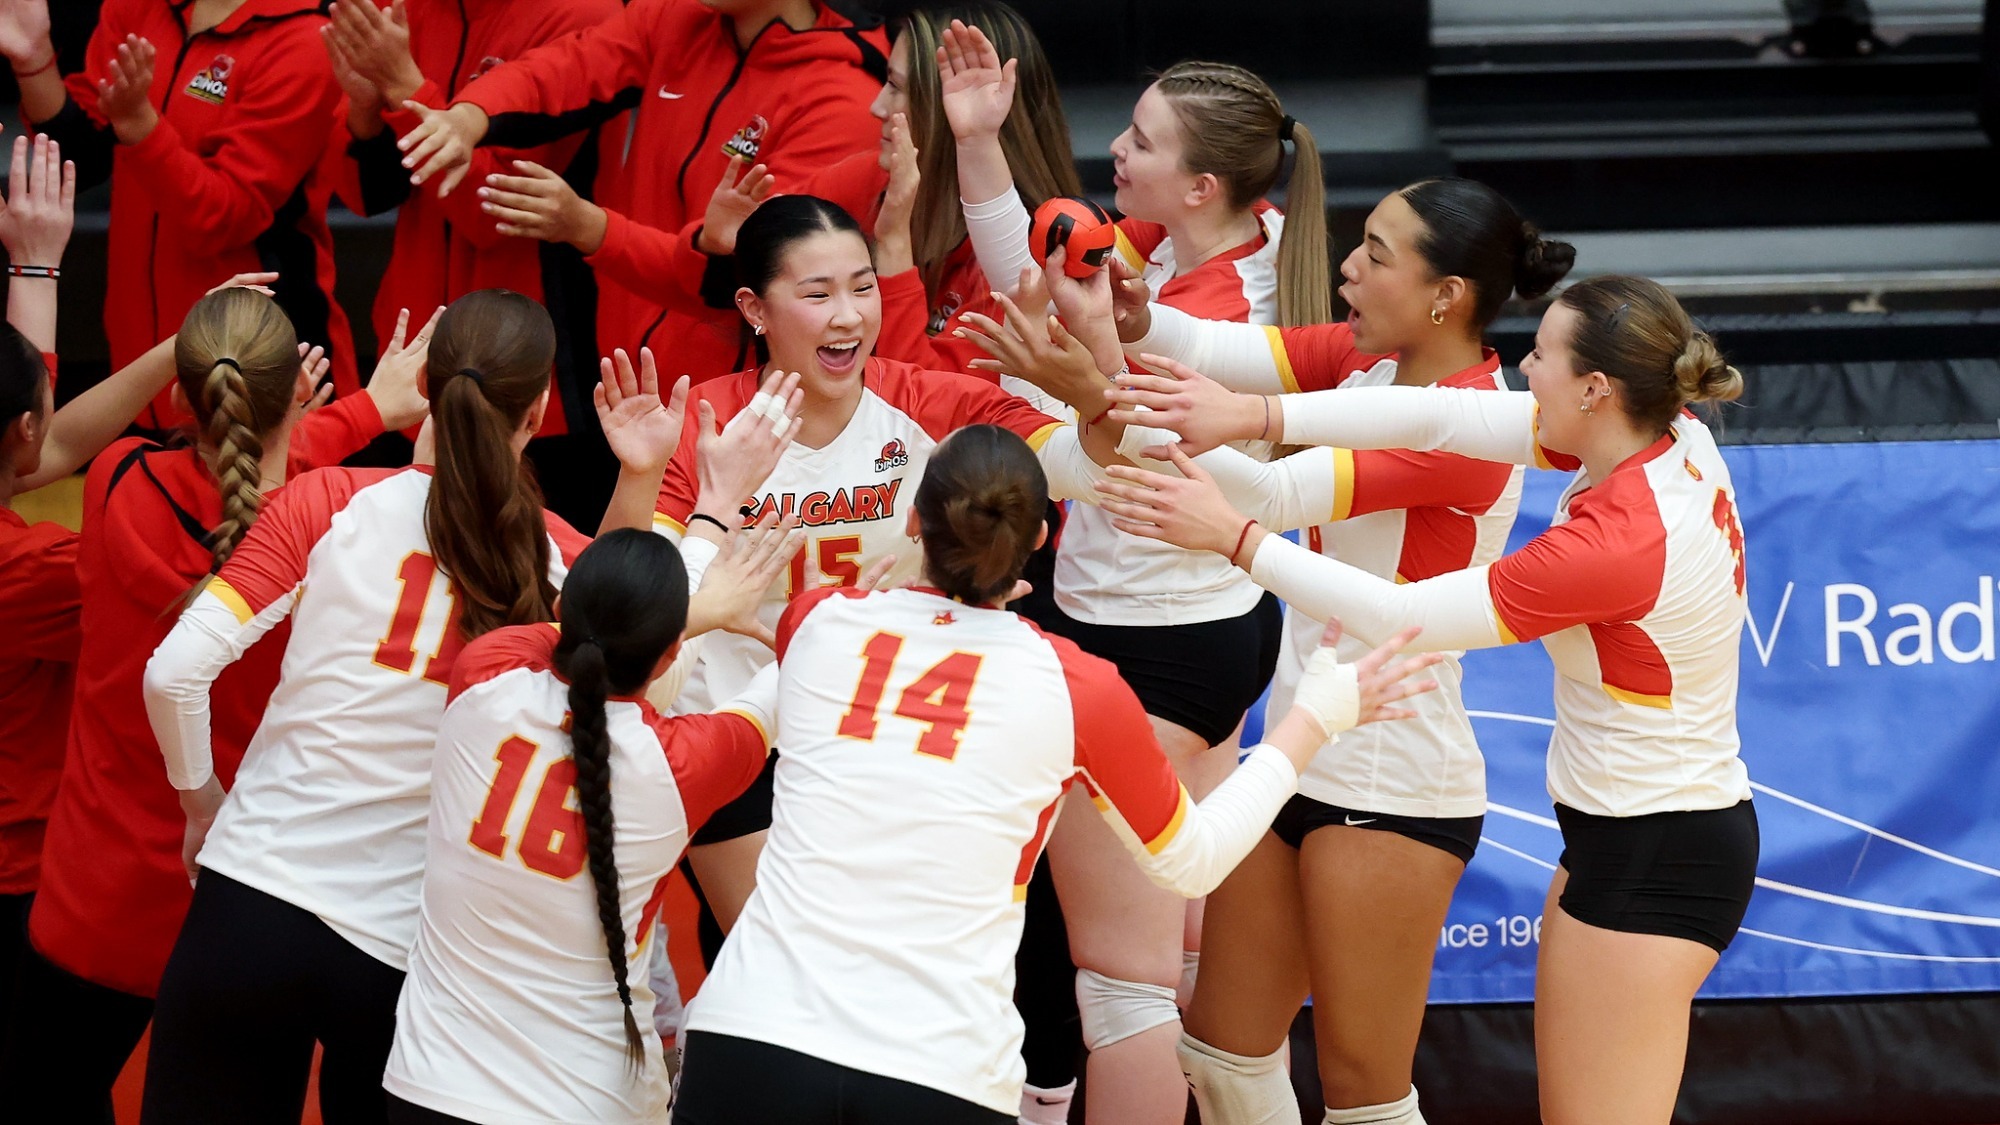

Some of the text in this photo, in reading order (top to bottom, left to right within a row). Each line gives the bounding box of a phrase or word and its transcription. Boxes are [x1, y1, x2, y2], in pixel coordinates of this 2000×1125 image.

[739, 478, 903, 530] CALGARY
[874, 455, 908, 472] DINOS
[785, 534, 863, 603] 15
[1824, 575, 2000, 668] Rad
[836, 629, 985, 764] 14
[467, 733, 612, 882] 16
